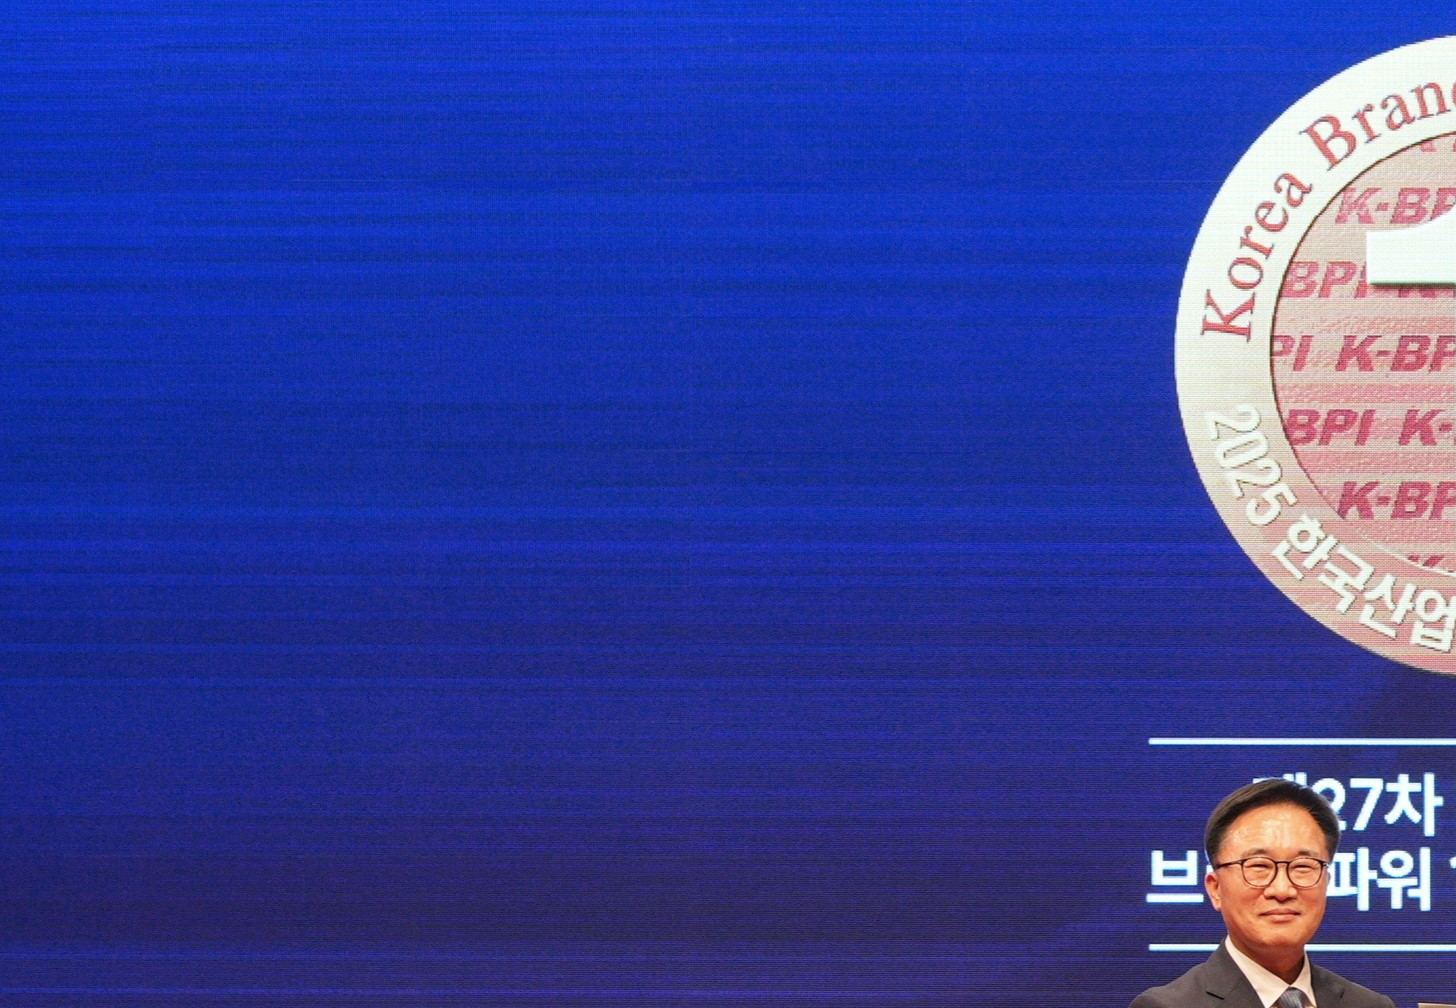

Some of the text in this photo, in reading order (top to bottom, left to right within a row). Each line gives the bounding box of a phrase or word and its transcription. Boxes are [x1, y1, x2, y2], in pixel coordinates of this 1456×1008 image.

[1202, 170, 1314, 342] Korea
[1204, 403, 1298, 527] 2025
[1253, 771, 1445, 837] 27차
